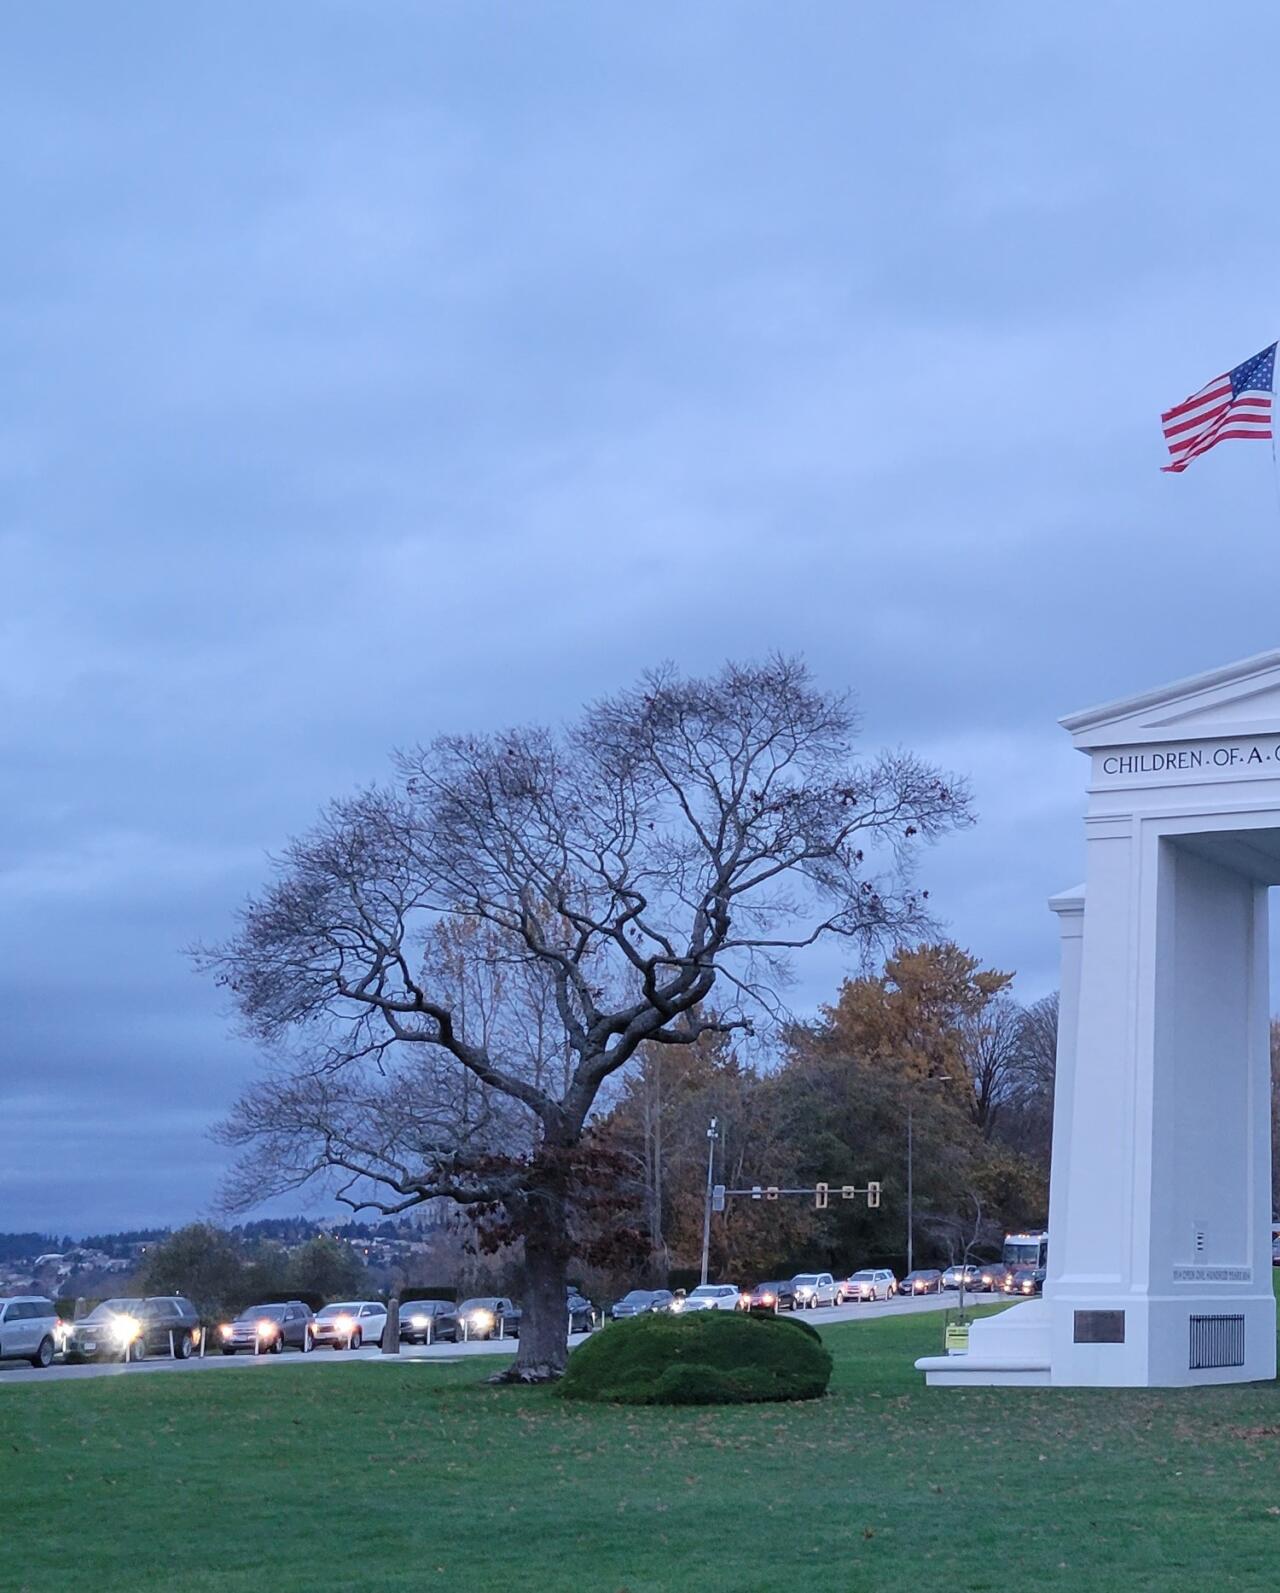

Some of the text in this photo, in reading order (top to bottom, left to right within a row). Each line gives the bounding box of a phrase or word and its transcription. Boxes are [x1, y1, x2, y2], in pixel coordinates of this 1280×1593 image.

[1103, 750, 1202, 774] CHILDREN
[1213, 748, 1239, 766] OF
[1247, 747, 1263, 763] A
